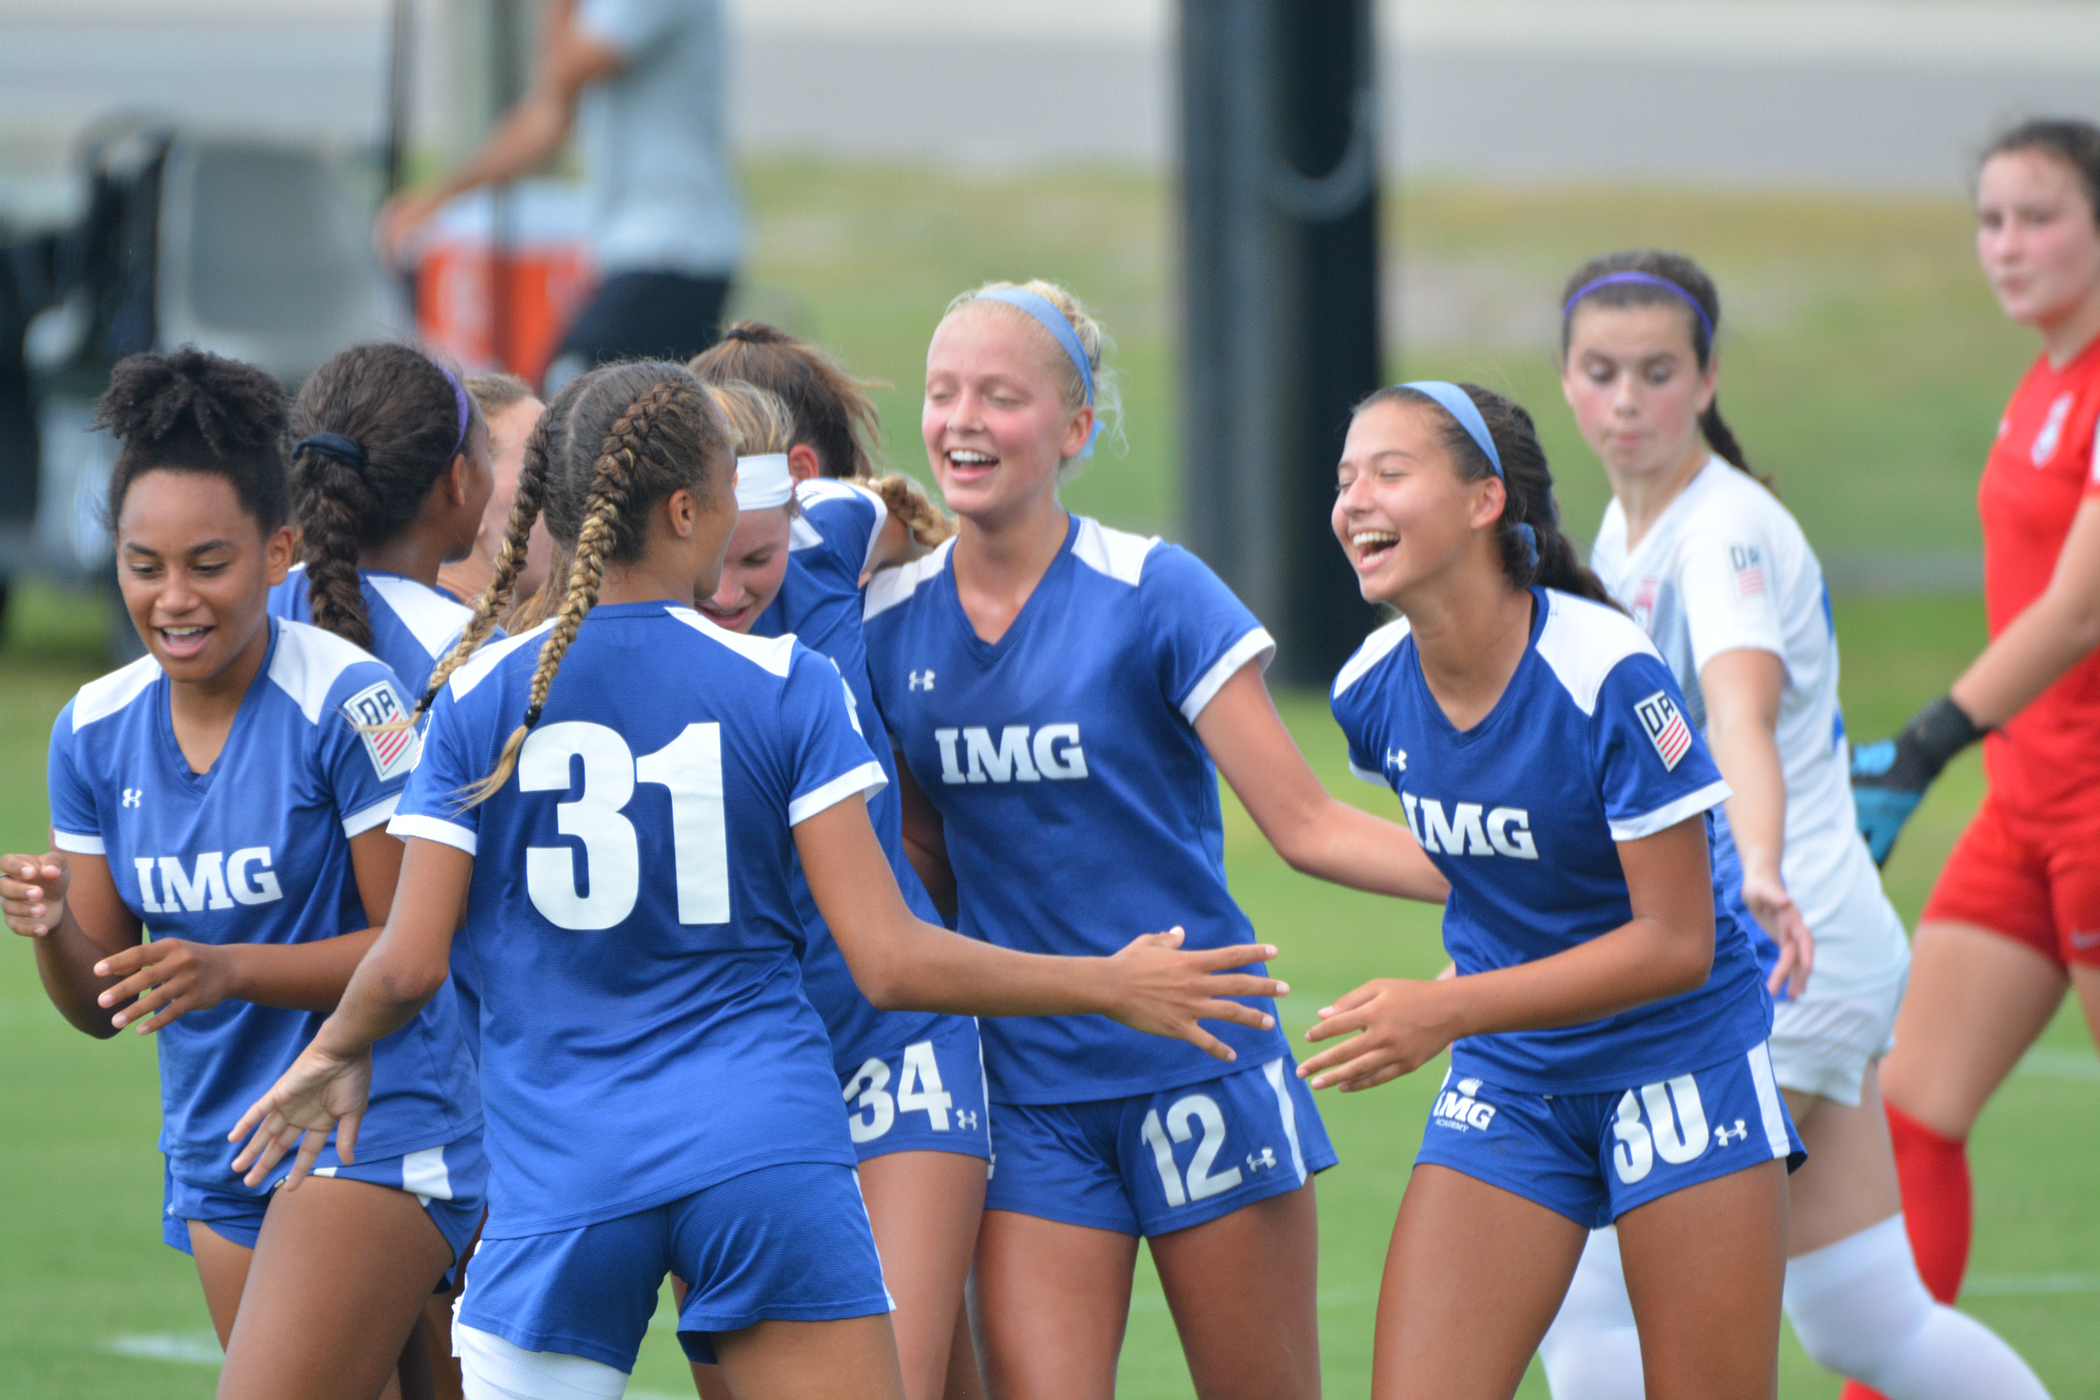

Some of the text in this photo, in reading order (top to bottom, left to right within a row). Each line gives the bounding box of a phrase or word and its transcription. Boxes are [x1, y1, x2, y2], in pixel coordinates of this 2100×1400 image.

[1730, 545, 1761, 571] DA
[357, 689, 396, 735] DA
[1639, 694, 1675, 738] DA
[935, 722, 1088, 784] IMG
[518, 720, 730, 930] 31
[1402, 790, 1539, 860] IMG
[134, 847, 283, 913] IMG
[842, 1039, 953, 1144] 34
[1433, 1090, 1496, 1132] IMG
[1141, 1094, 1243, 1208] 12
[1612, 1073, 1709, 1185] 30
